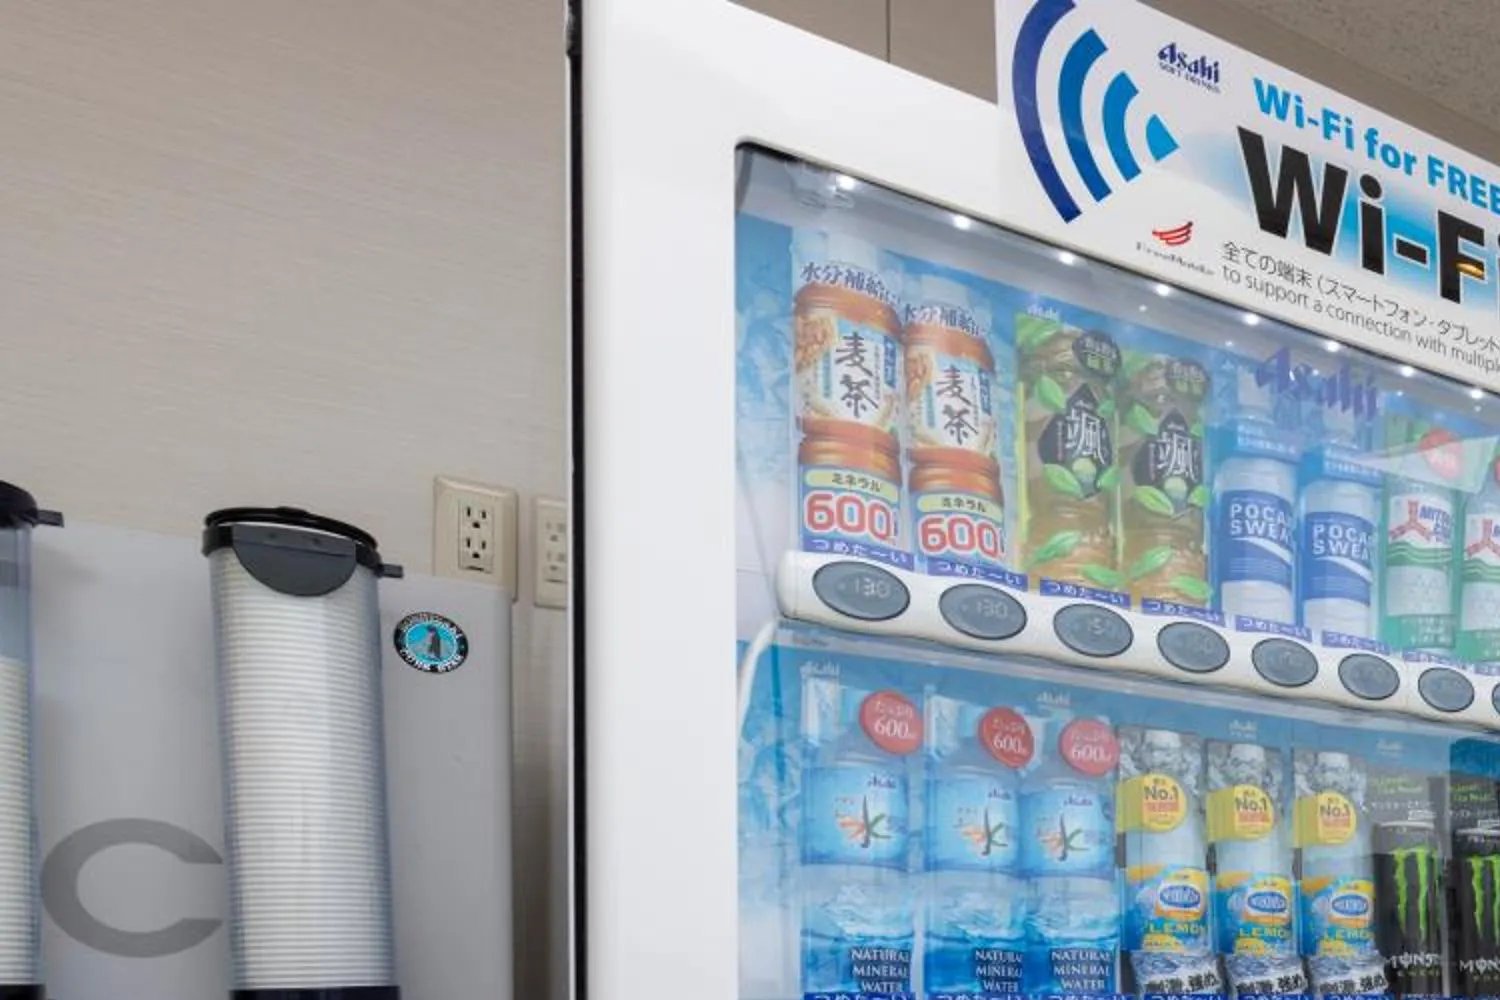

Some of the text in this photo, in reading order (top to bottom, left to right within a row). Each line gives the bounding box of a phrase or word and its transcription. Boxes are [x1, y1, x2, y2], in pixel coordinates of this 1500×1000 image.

[1158, 42, 1219, 84] Asahi
[1253, 76, 1356, 151] Wi-Fi
[1363, 127, 1418, 176] for
[1222, 264, 1242, 284] to
[1246, 275, 1310, 307] support
[1326, 303, 1412, 342] connection
[1416, 333, 1448, 357] with
[834, 331, 880, 419] 麦茶
[935, 364, 978, 444] 麦茶
[1143, 785, 1179, 801] No.1
[1234, 797, 1268, 812] No.1
[1319, 804, 1351, 819] No.1
[1060, 978, 1105, 991] WATER
